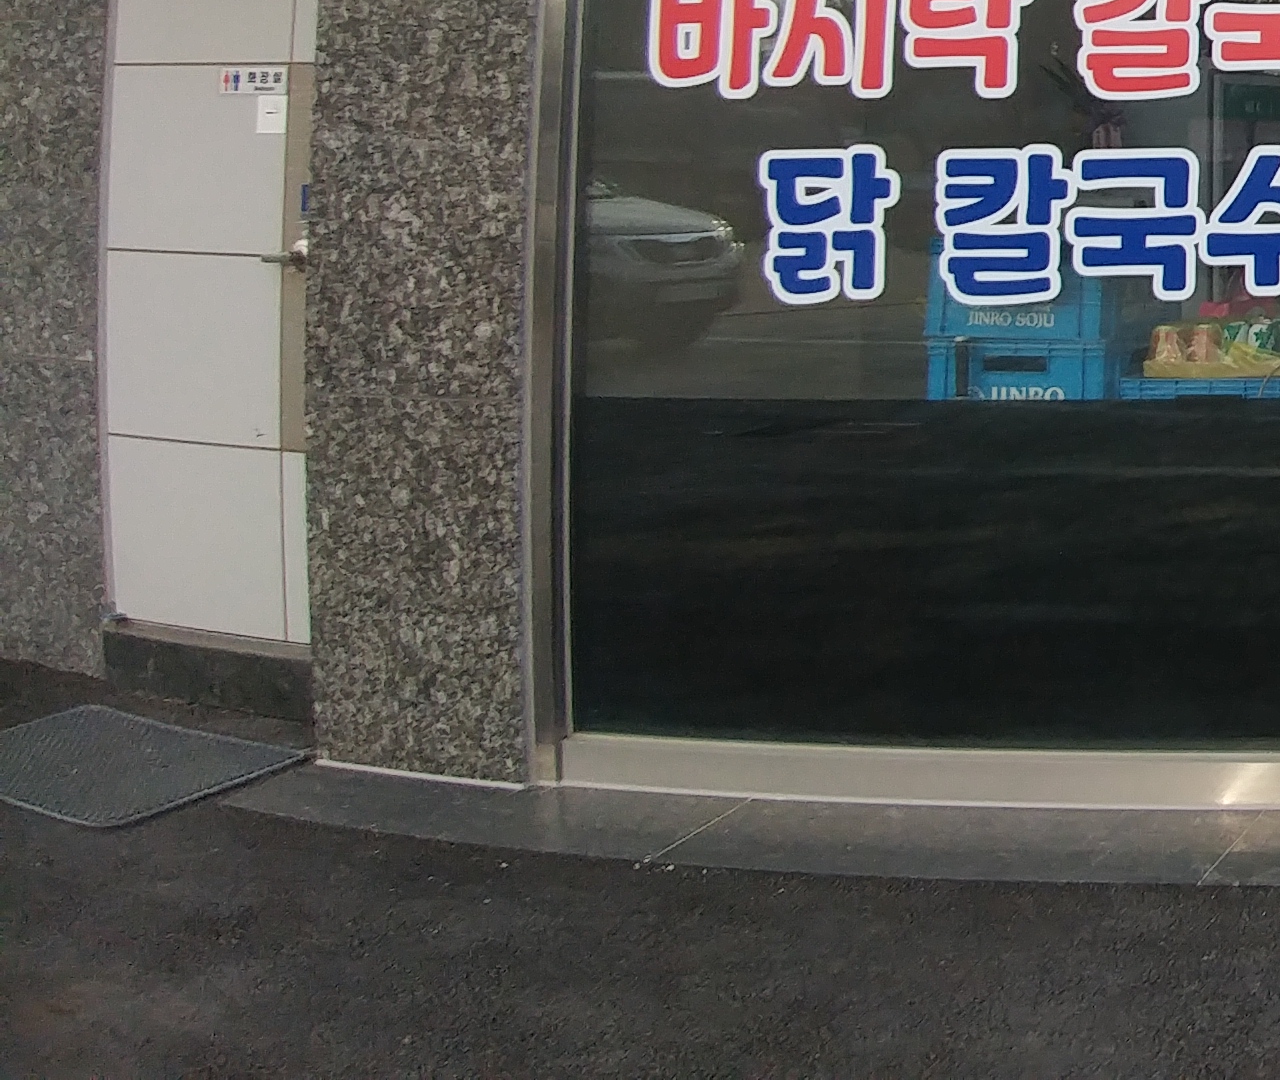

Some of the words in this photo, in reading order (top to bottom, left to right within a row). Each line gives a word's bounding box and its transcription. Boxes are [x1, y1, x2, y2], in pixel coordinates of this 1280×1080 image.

[759, 143, 901, 305] 닭
[967, 311, 1012, 327] JINRO
[1015, 312, 1055, 328] SOJU
